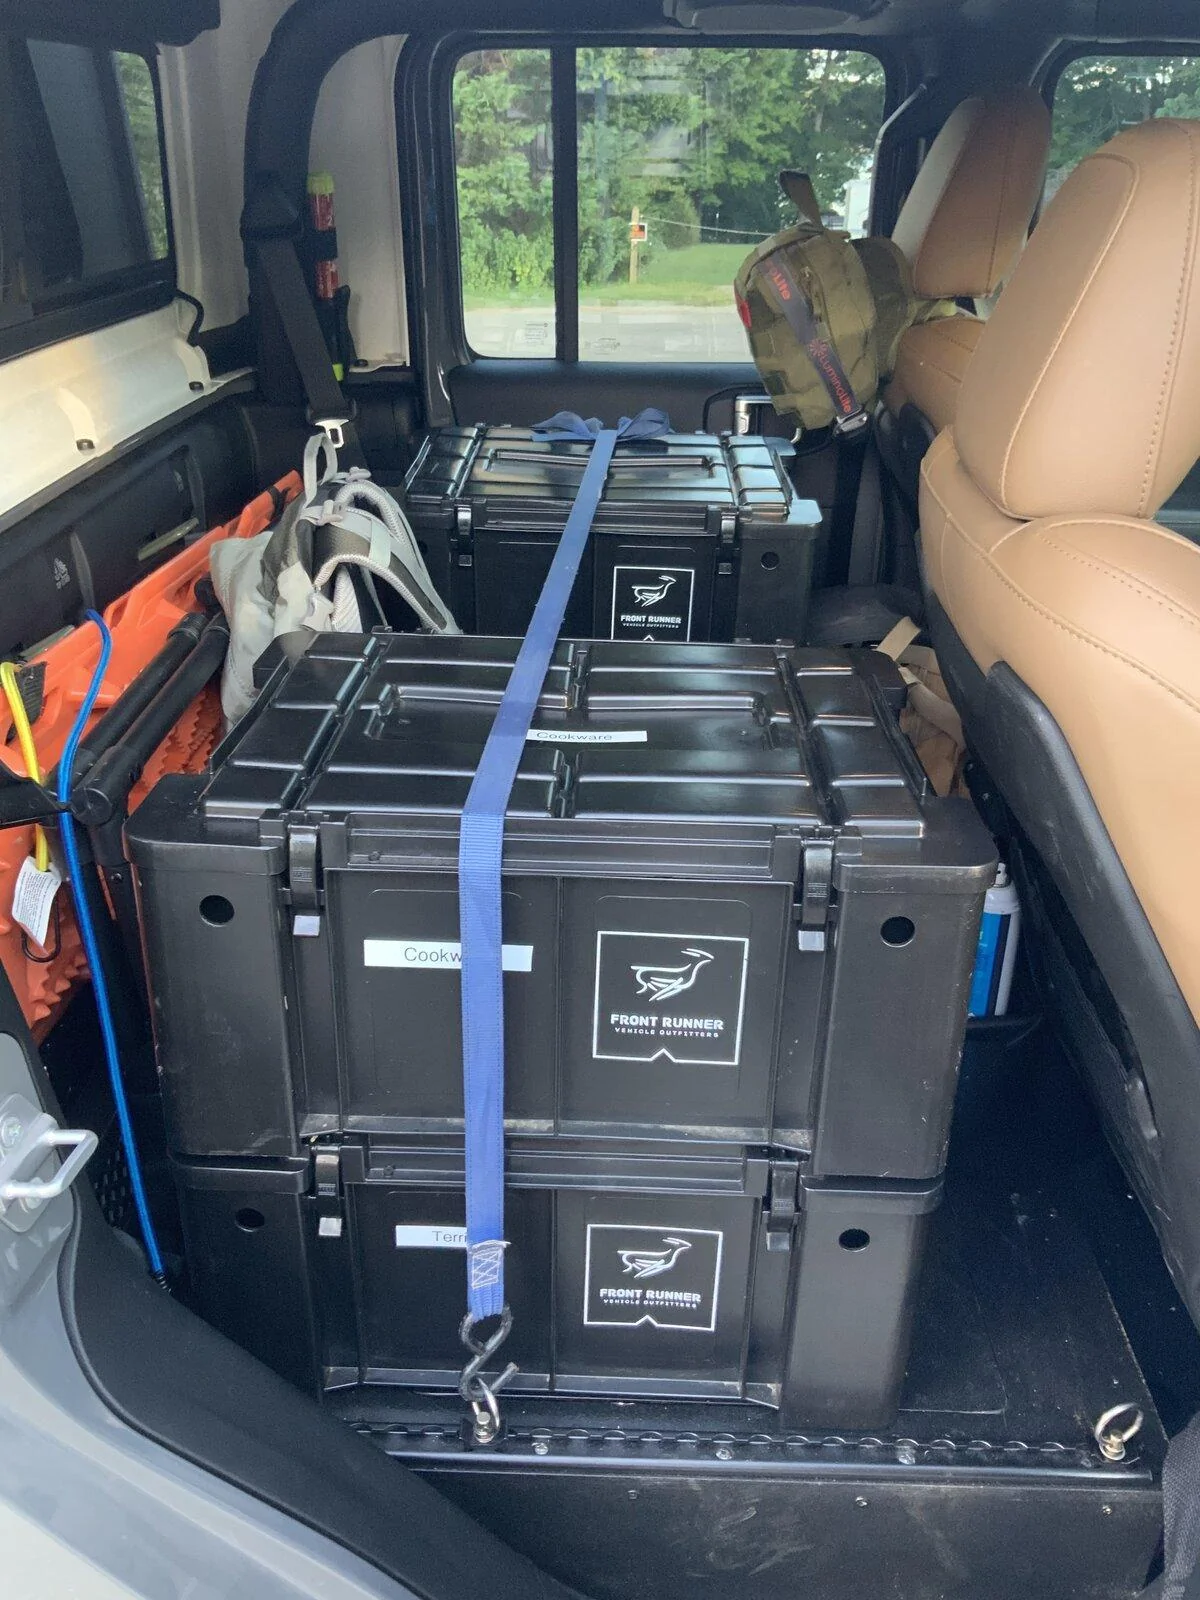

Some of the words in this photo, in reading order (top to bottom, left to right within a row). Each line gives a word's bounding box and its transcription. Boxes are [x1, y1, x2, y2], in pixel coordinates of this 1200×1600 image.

[620, 614, 647, 623] FRONT
[648, 616, 682, 624] RUNNER
[536, 731, 613, 741] Cookware
[404, 947, 463, 962] Cookw
[610, 1014, 658, 1027] FRONT
[662, 1017, 724, 1030] RUNNER
[614, 1027, 656, 1035] VEHICLE
[659, 1030, 719, 1038] OUTFITTERS
[431, 1230, 467, 1243] Terri
[599, 1288, 643, 1298] FRONT
[645, 1290, 702, 1302] RUNNER
[643, 1300, 697, 1308] OUTFITTERS
